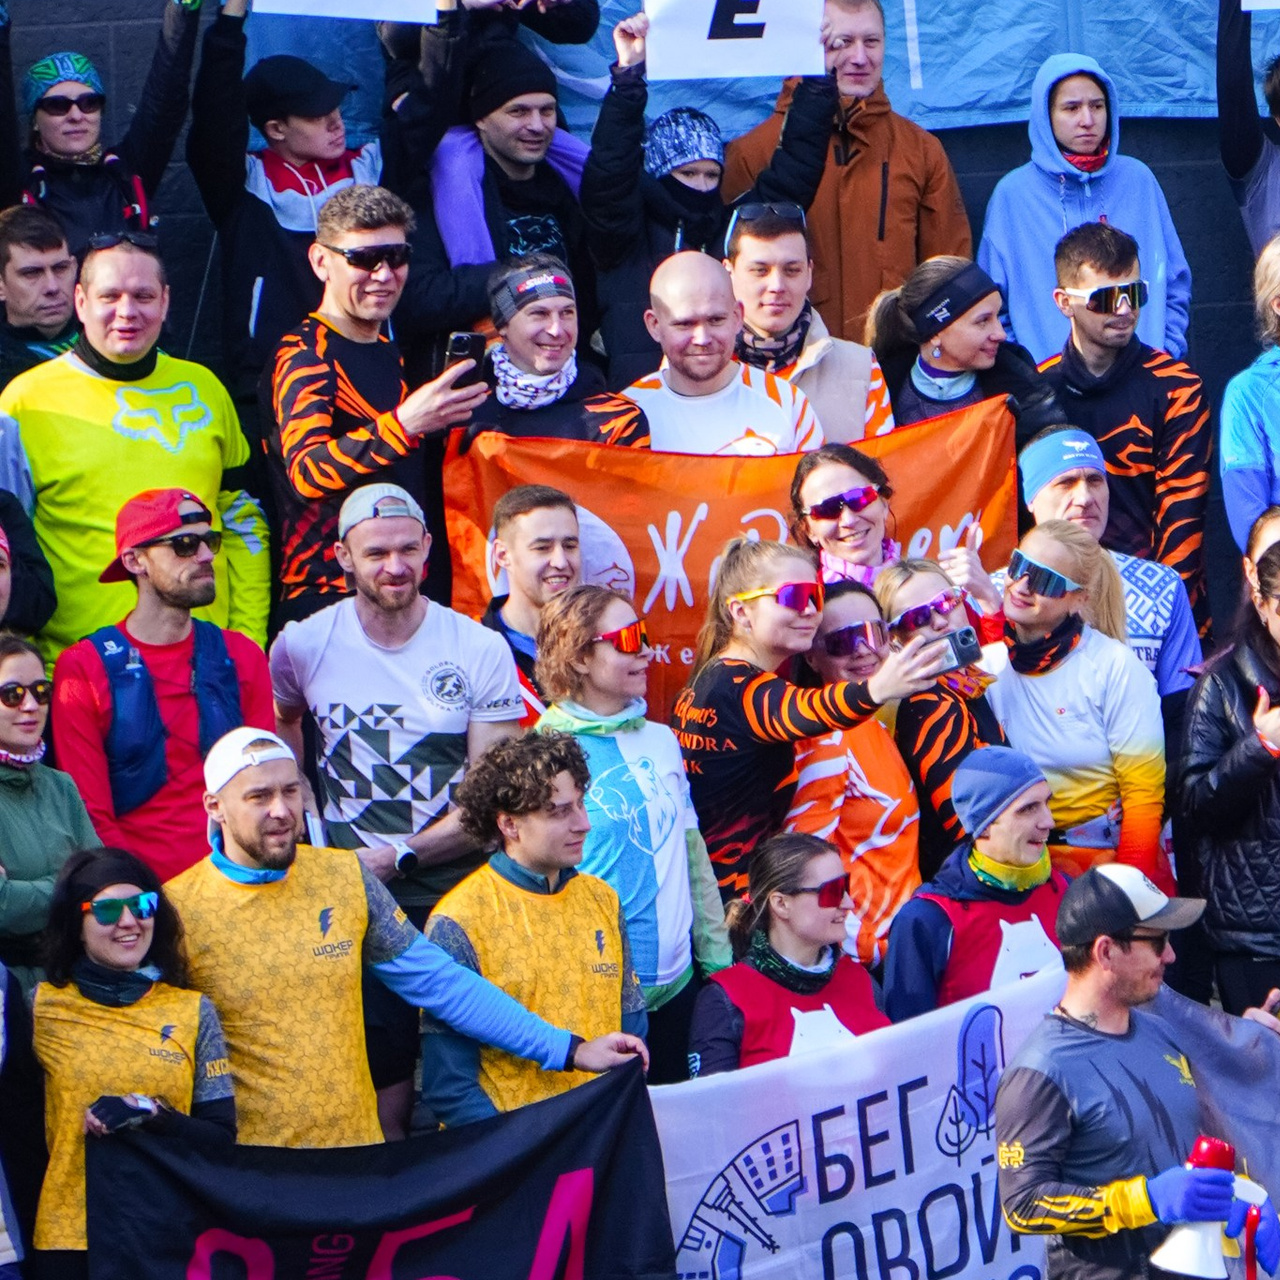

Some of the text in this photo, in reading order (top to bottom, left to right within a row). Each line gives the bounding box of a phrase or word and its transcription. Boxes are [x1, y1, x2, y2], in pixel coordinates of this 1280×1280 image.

[312, 939, 354, 957] ШОКЕР
[591, 962, 619, 974] ШОКЕ
[812, 1076, 929, 1205] БЕГ
